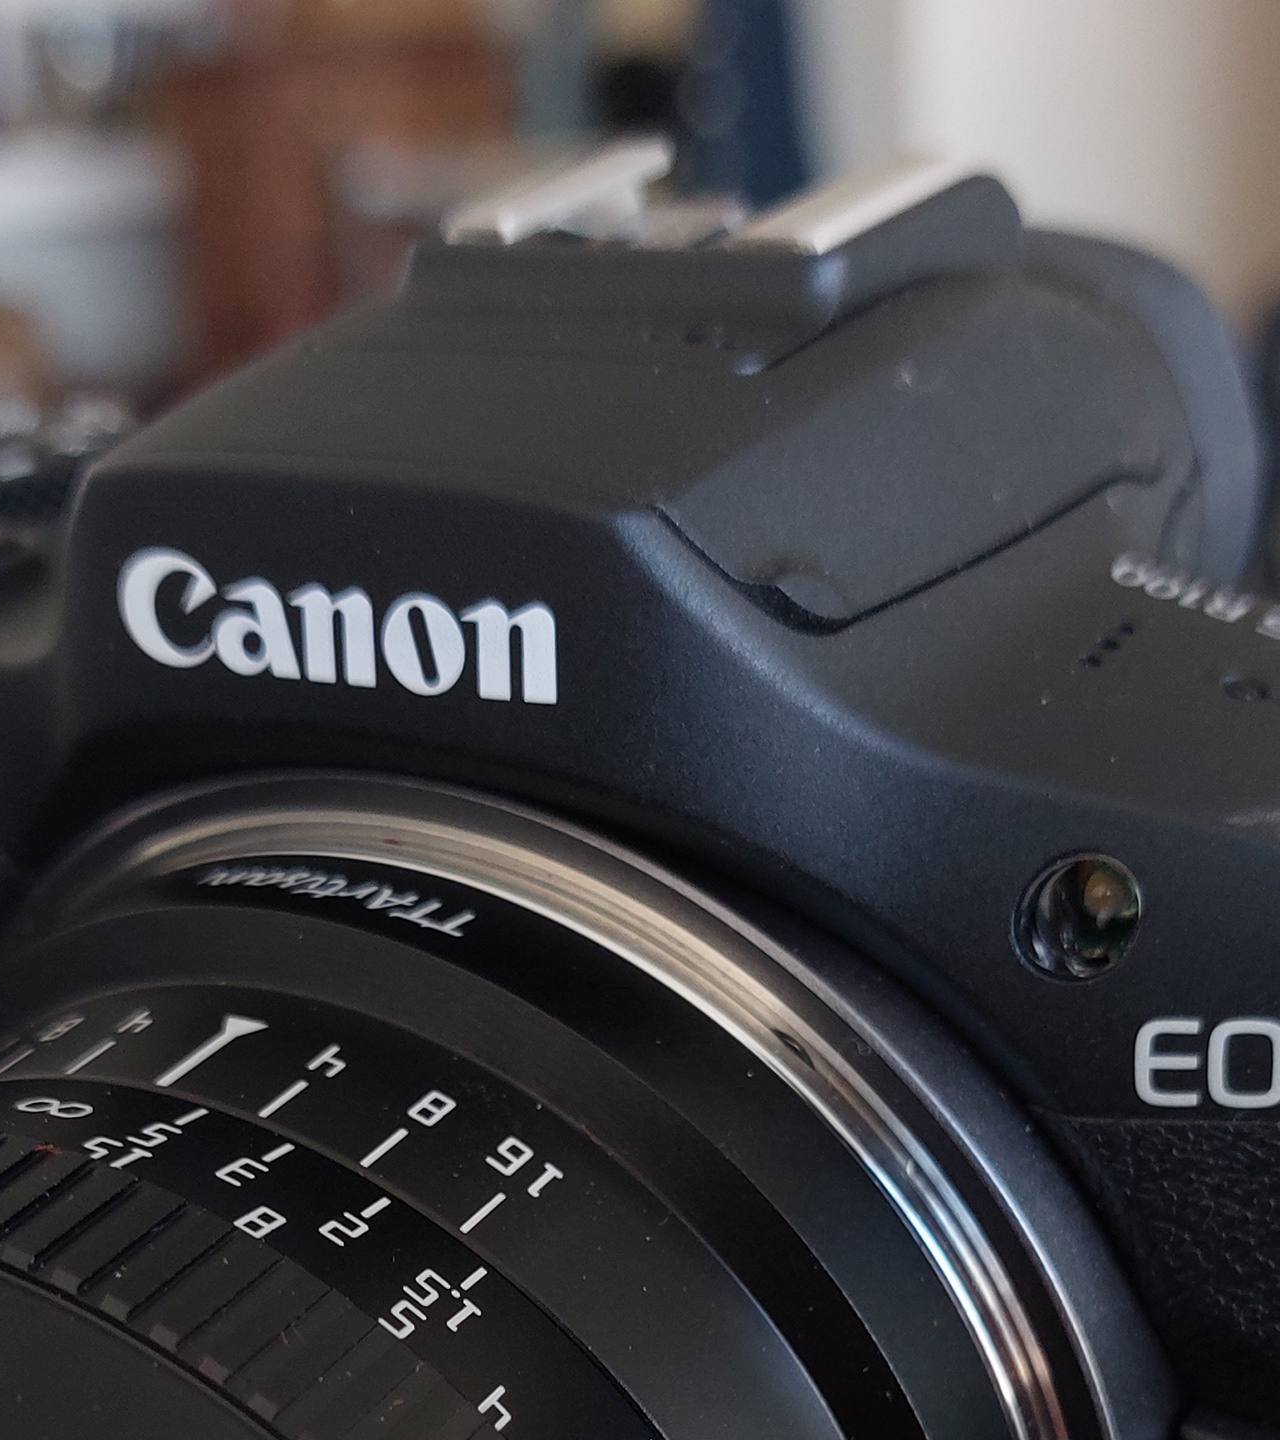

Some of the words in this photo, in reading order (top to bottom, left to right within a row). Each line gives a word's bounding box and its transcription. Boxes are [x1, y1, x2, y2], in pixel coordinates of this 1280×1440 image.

[1111, 553, 1250, 623] R100
[120, 548, 558, 705] Canon
[202, 864, 478, 938] TTArtisan
[117, 1010, 153, 1035] 4
[307, 1045, 347, 1078] 4
[408, 1090, 457, 1127] 8
[485, 1136, 564, 1198] 16
[140, 1119, 183, 1149] 5
[216, 1156, 269, 1187] 3
[318, 1210, 369, 1247] 2
[402, 1268, 482, 1334] 1.5
[84, 1137, 153, 1169] 15
[233, 1205, 287, 1239] 8
[379, 1299, 426, 1339] 5
[477, 1385, 512, 1431] 4
